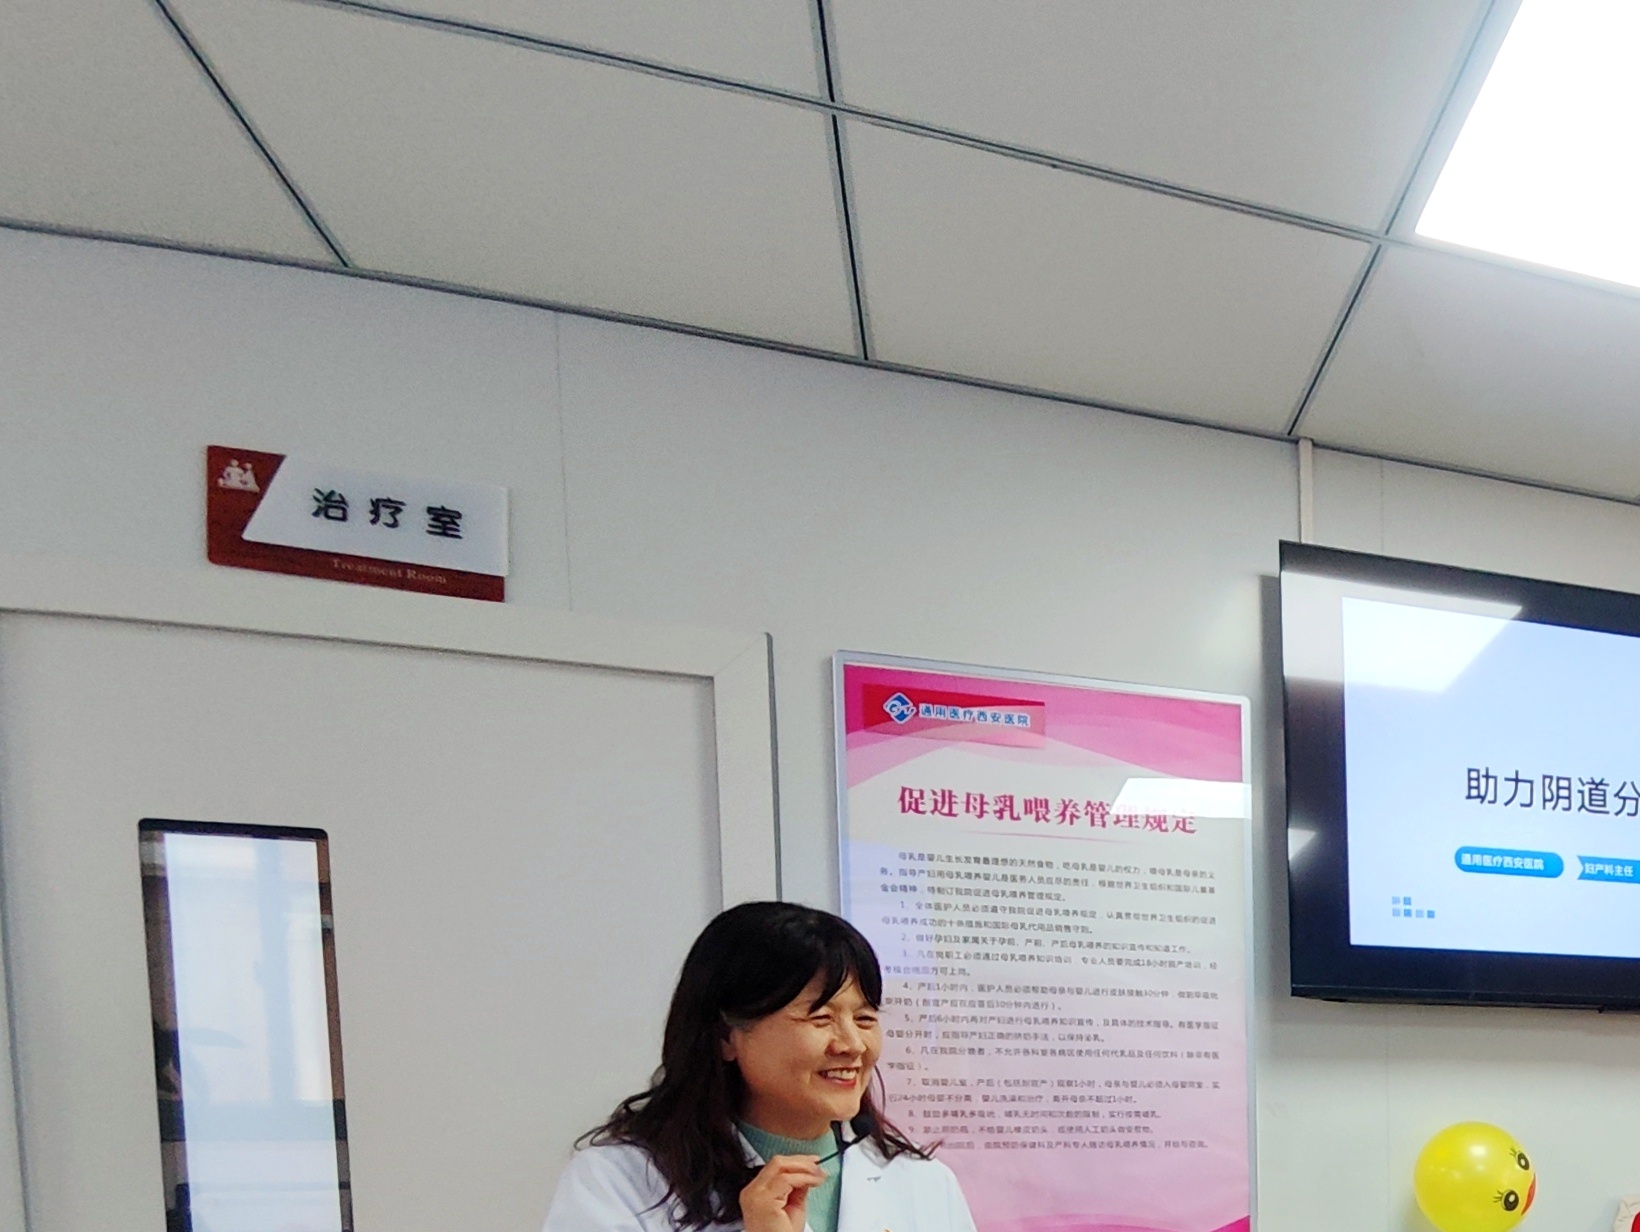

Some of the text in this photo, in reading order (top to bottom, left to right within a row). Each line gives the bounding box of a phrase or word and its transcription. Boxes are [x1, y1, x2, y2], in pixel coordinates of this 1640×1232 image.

[312, 487, 463, 540] 治疗室
[406, 569, 447, 585] Room
[921, 704, 1029, 727] 通用医疗西安医院
[897, 785, 1198, 835] 促进母乳喂养管理规定
[1461, 852, 1545, 871] 通用医疗西安医院
[1584, 861, 1634, 878] 妇产科主任
